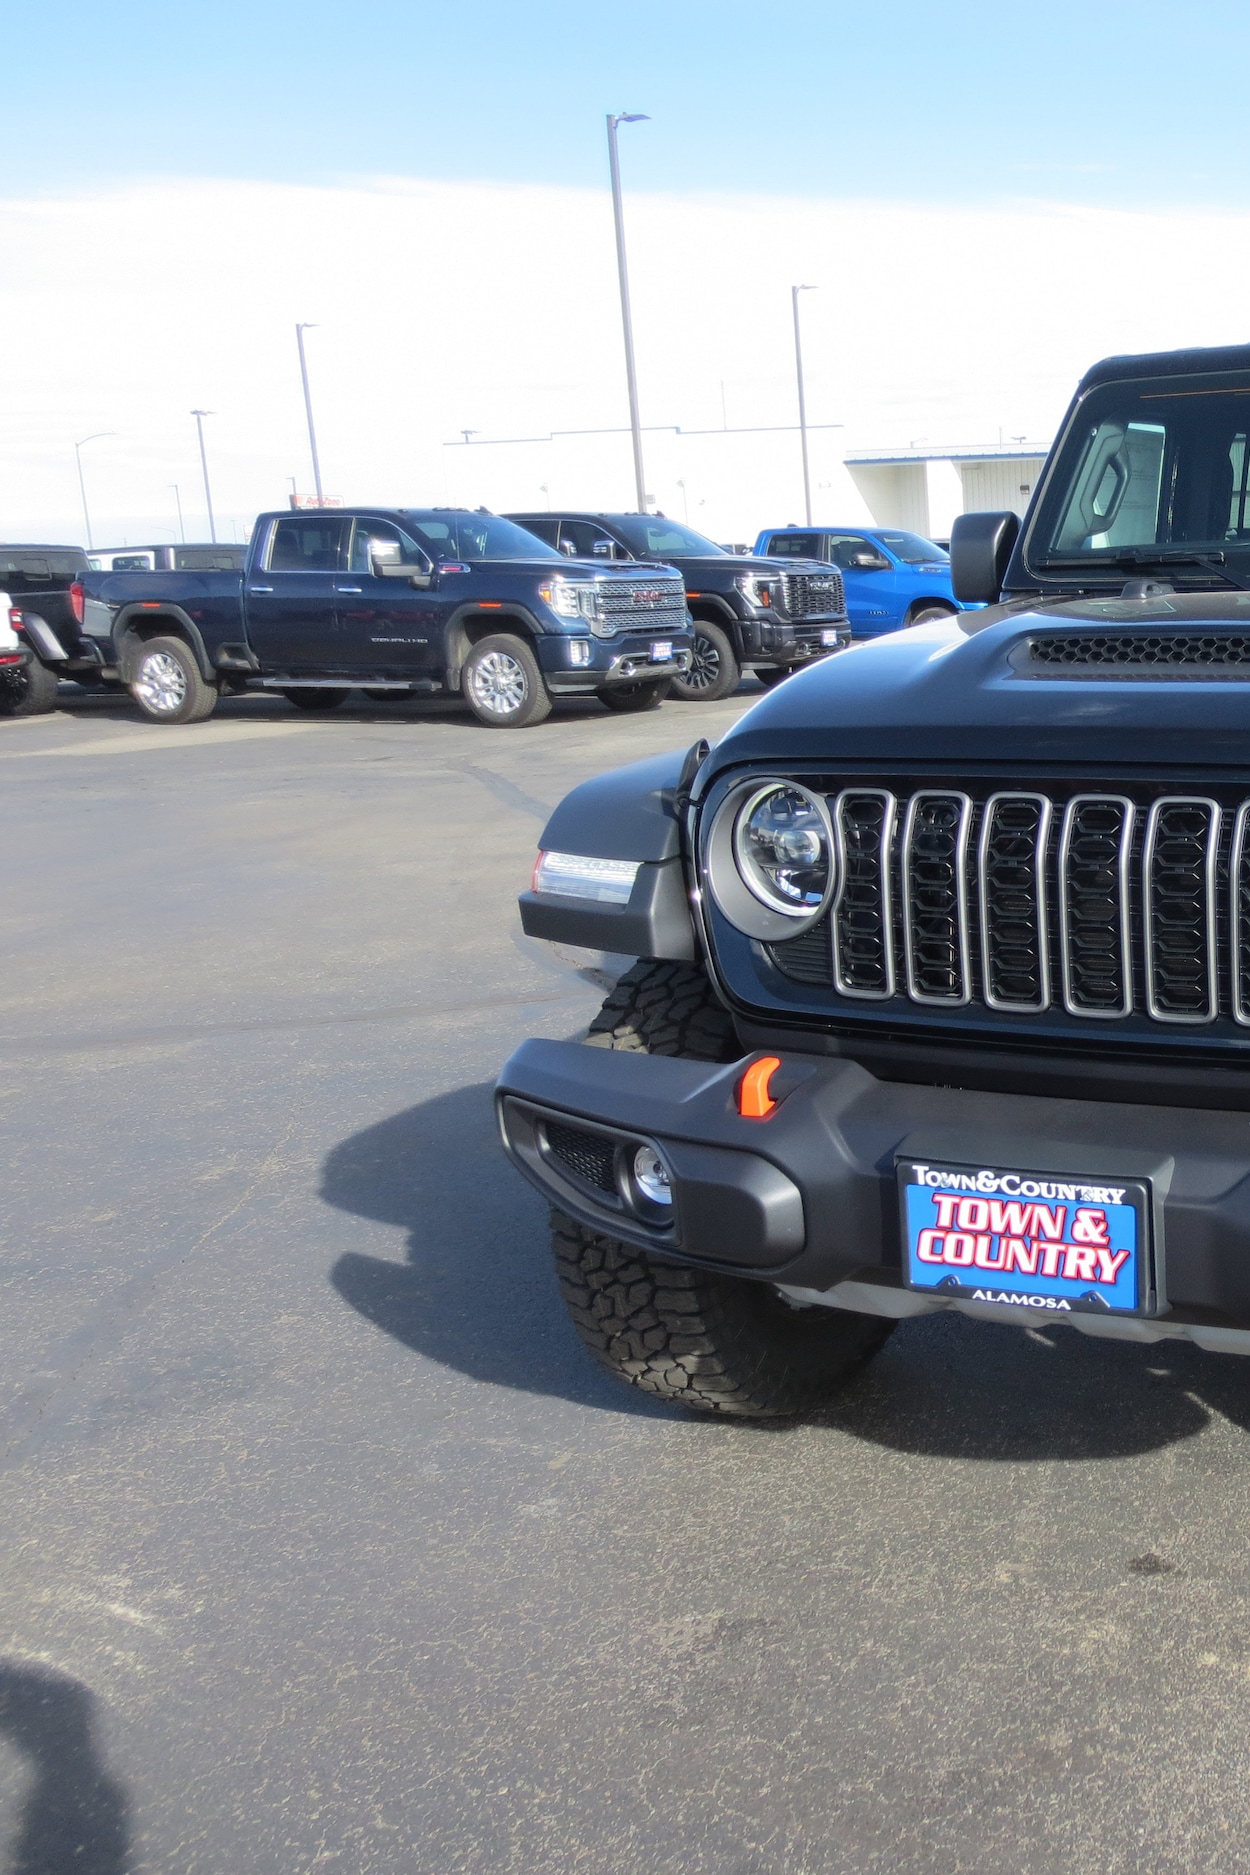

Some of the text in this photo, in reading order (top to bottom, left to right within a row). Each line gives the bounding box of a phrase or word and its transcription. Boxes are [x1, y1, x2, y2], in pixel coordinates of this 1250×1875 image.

[306, 496, 341, 506] AutZone
[932, 1193, 1111, 1246] TOWN &
[917, 1228, 1130, 1284] COUNTRY
[972, 1289, 1071, 1311] ALAMOSA
